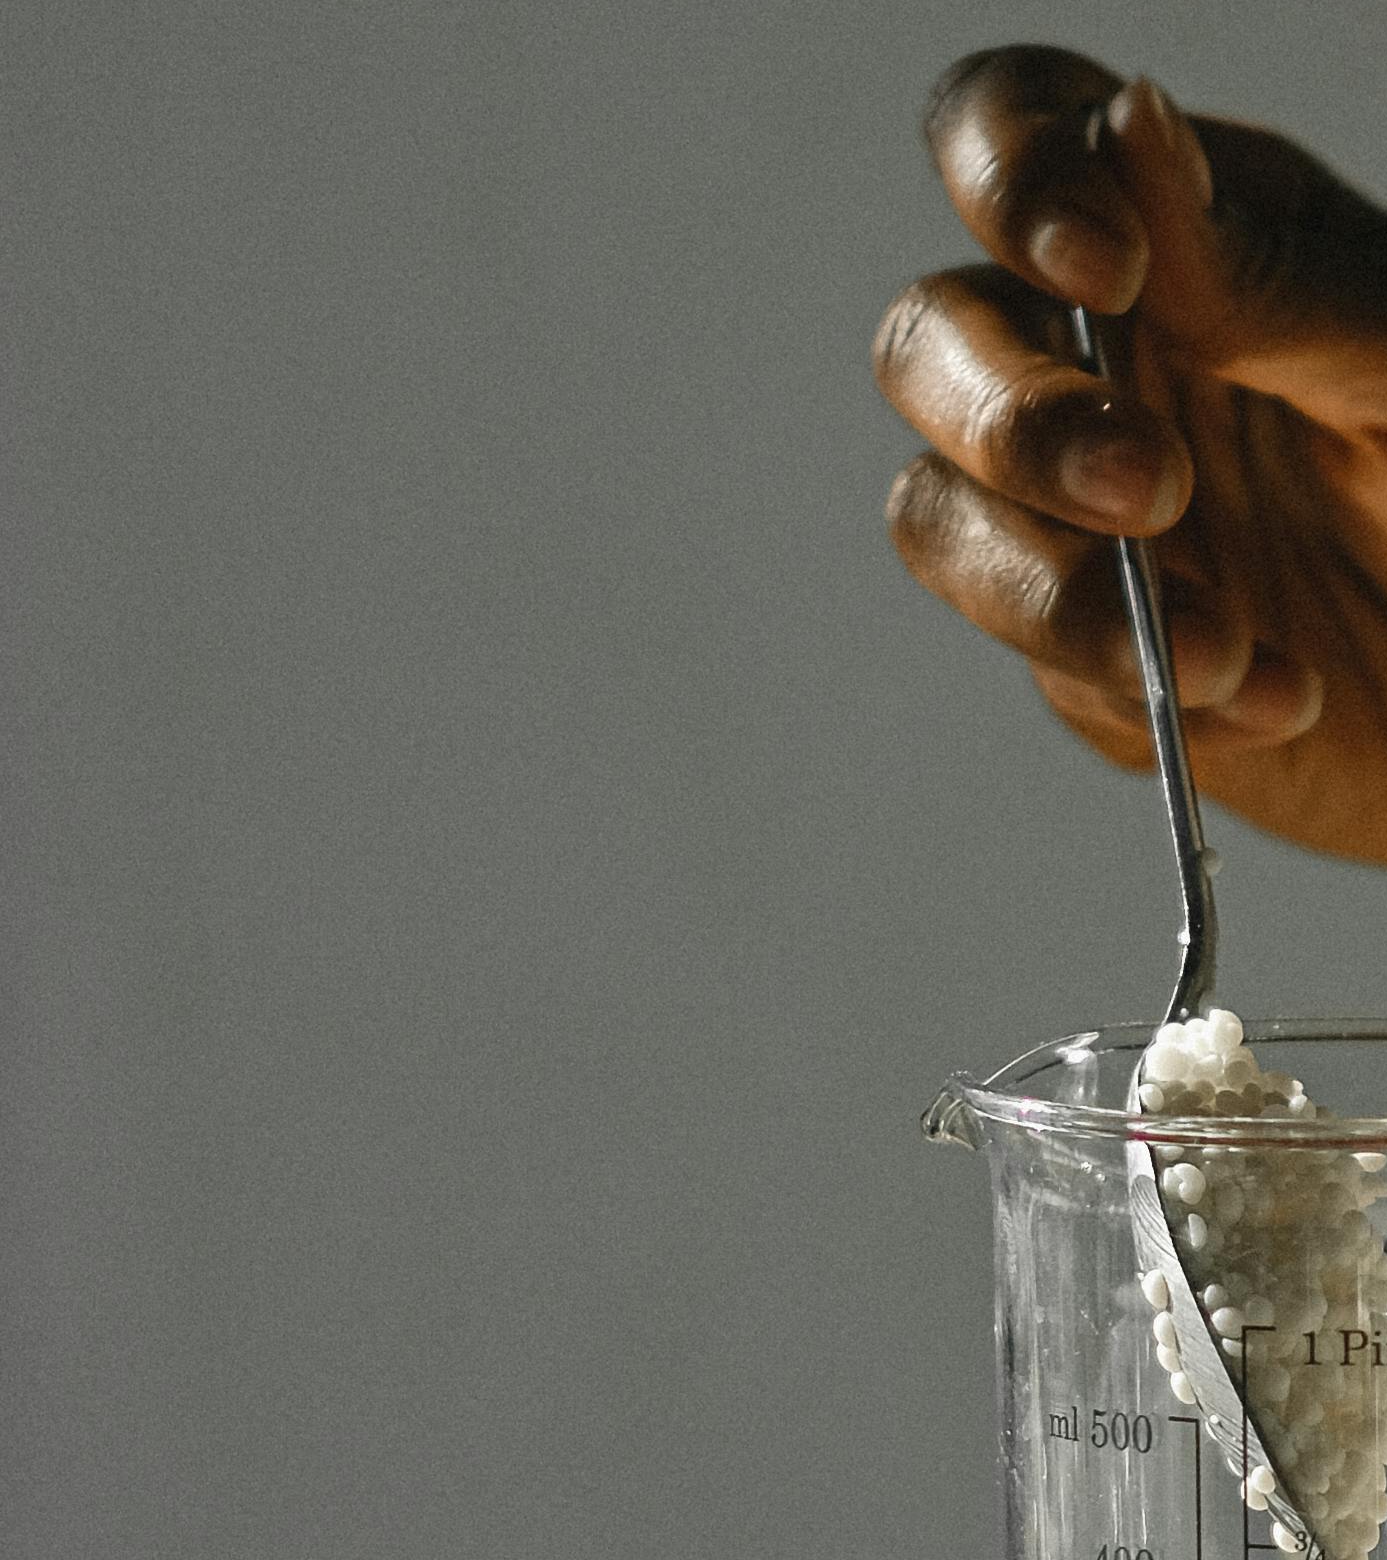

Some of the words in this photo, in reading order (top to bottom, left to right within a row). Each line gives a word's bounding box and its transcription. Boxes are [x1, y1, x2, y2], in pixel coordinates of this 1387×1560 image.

[1302, 1331, 1322, 1367] 1
[1048, 1405, 1080, 1442] ml
[1091, 1408, 1153, 1454] 500
